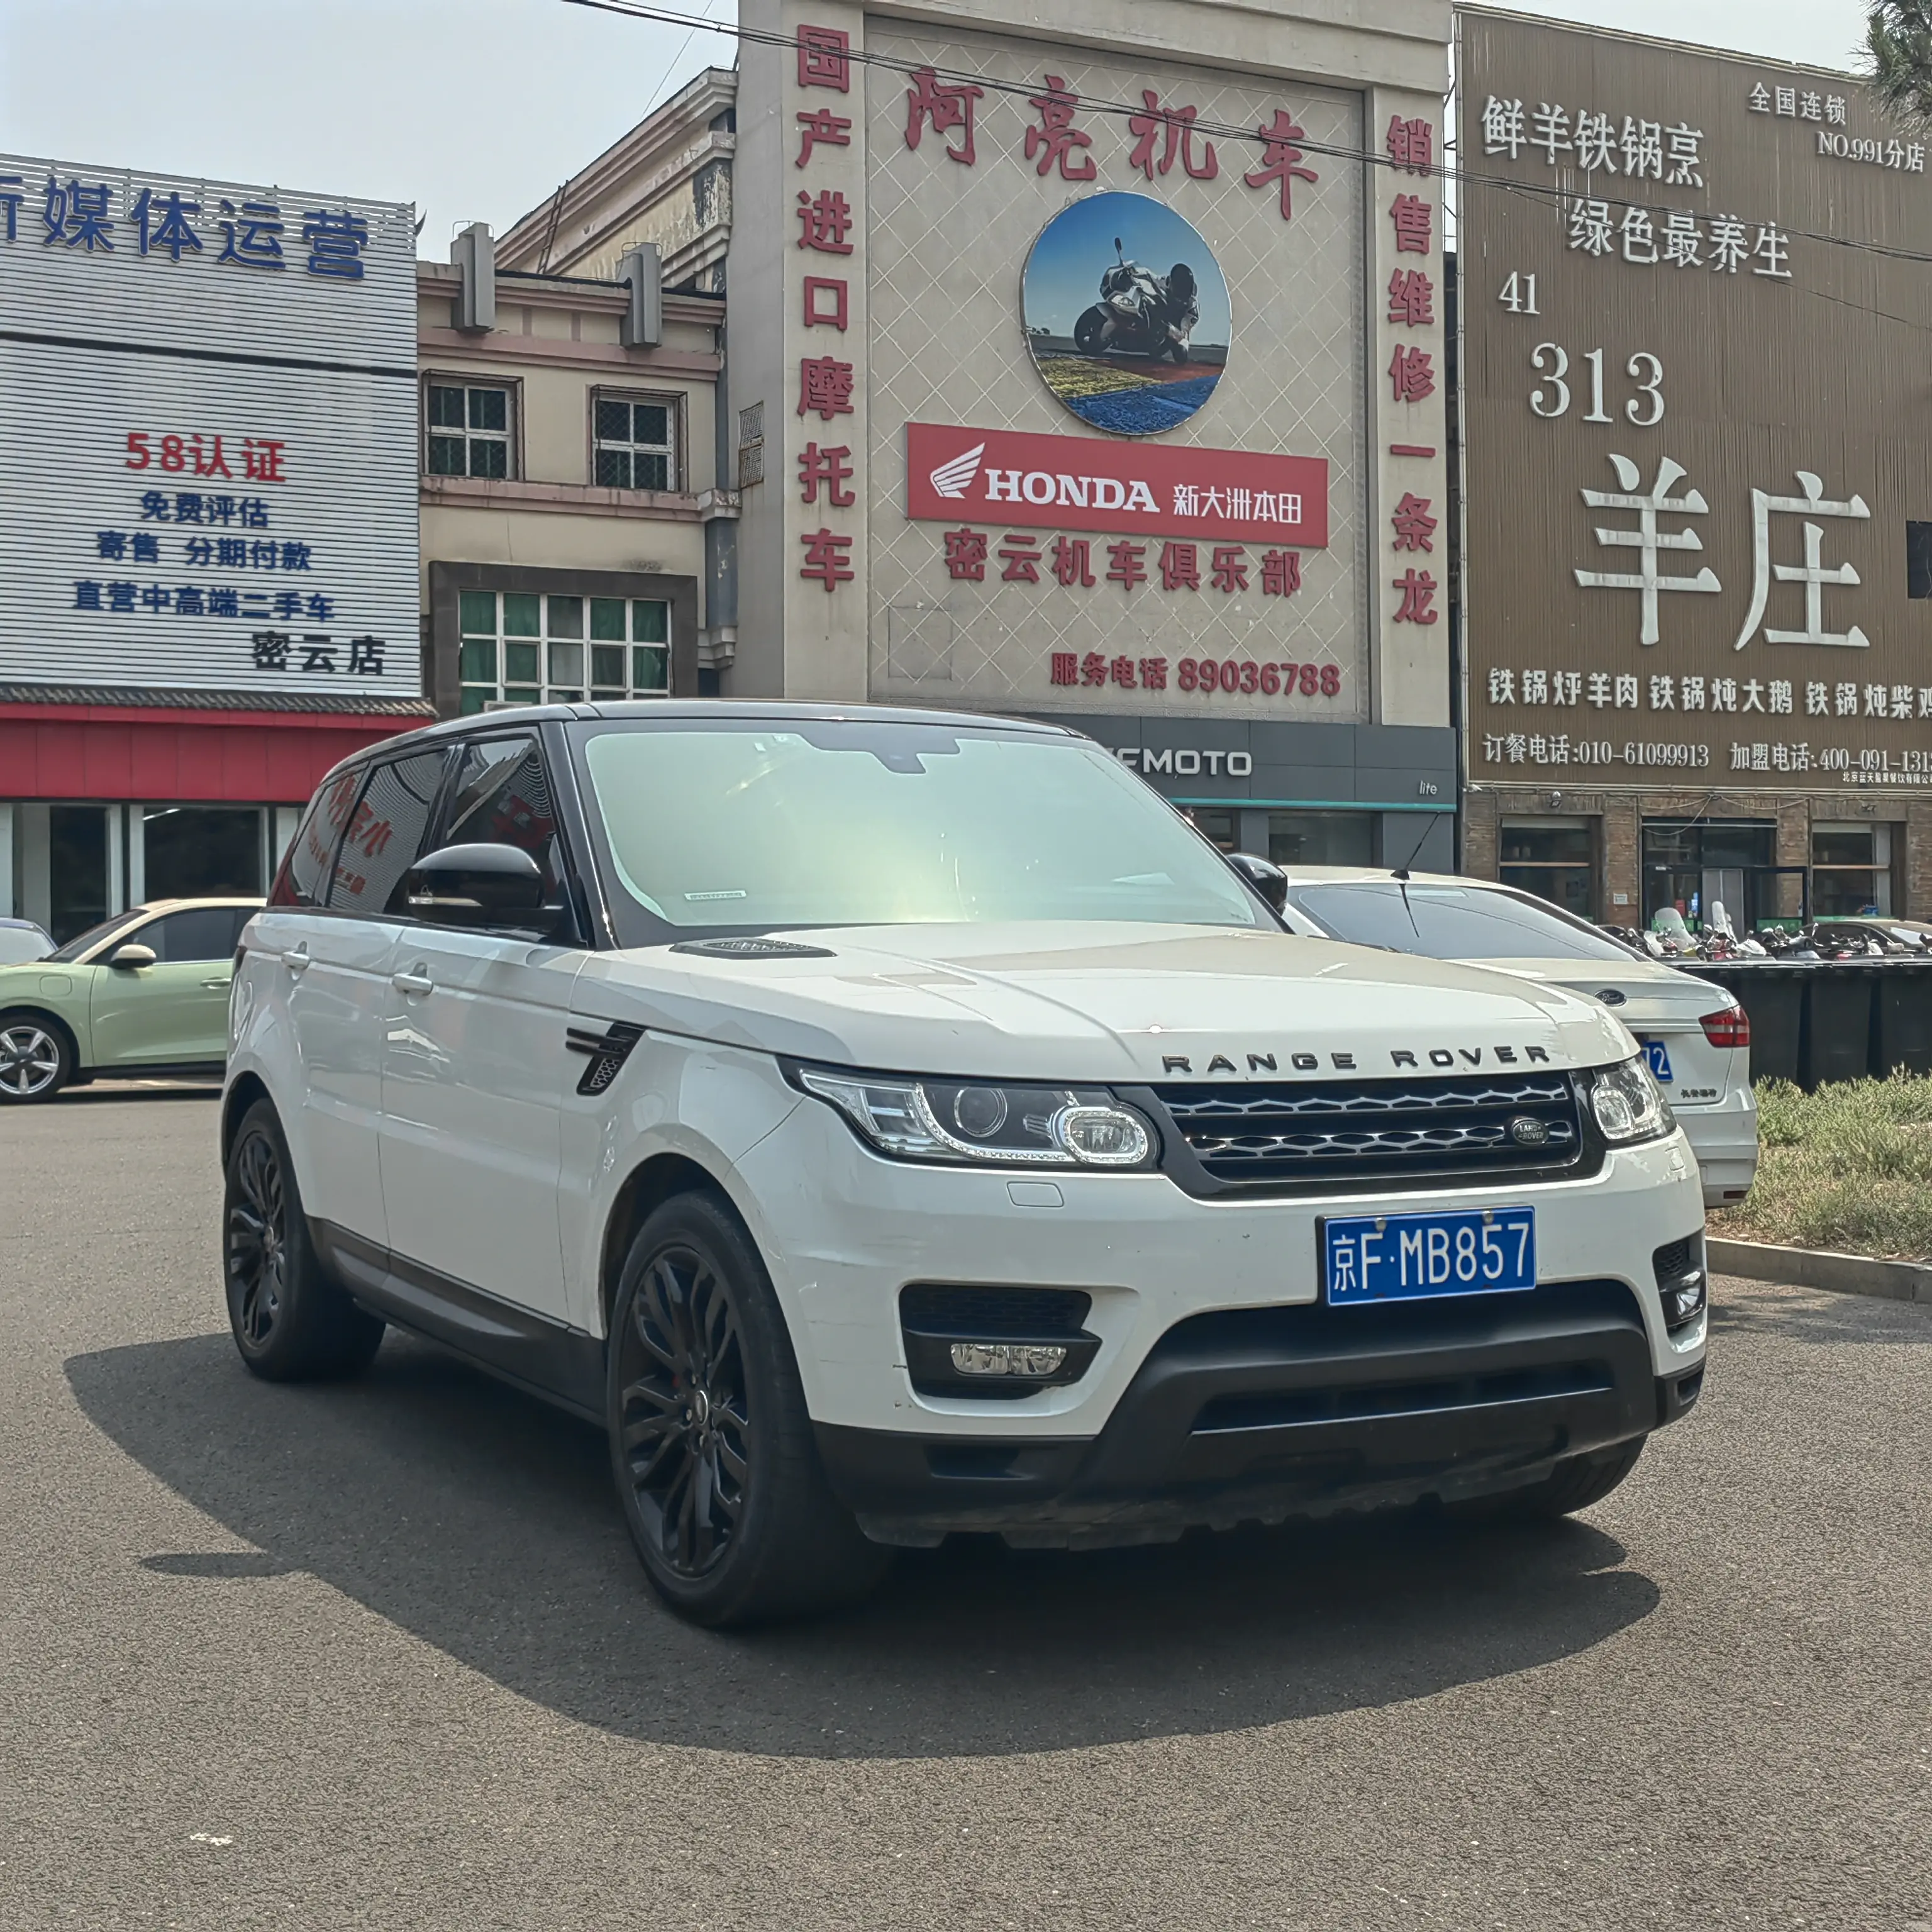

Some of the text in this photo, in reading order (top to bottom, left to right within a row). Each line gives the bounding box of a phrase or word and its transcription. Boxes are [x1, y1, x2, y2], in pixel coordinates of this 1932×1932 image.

[1748, 82, 1846, 125] 全国连锁
[1480, 94, 1704, 187] 鲜羊铁锅烹
[1816, 131, 1925, 173] NO.991分店
[1568, 197, 1792, 278] 绿色最养生
[796, 24, 855, 592] 国产进口摩托车
[1498, 271, 1541, 314] 41
[1387, 114, 1438, 625] 销售维修一条龙
[1530, 342, 1665, 426] 313
[126, 432, 287, 482] 58认证
[140, 491, 270, 528] 免费评估
[985, 469, 1302, 525] HONDA 新大洲本田
[96, 531, 312, 571] 寄售 分期付款
[944, 528, 1302, 597] 密云机车俱乐部
[1574, 453, 1871, 650] 羊庄
[72, 580, 335, 623] 直营中高端二手车
[251, 630, 386, 675] 密云店
[1050, 651, 1341, 697] 服务电话 89036788
[1648, 675, 1793, 714] 铁锅炖大鹅
[1419, 780, 1438, 795] lite
[1162, 1045, 1550, 1072] RANGE ROVER
[1333, 1223, 1530, 1291] 京F·MB857
